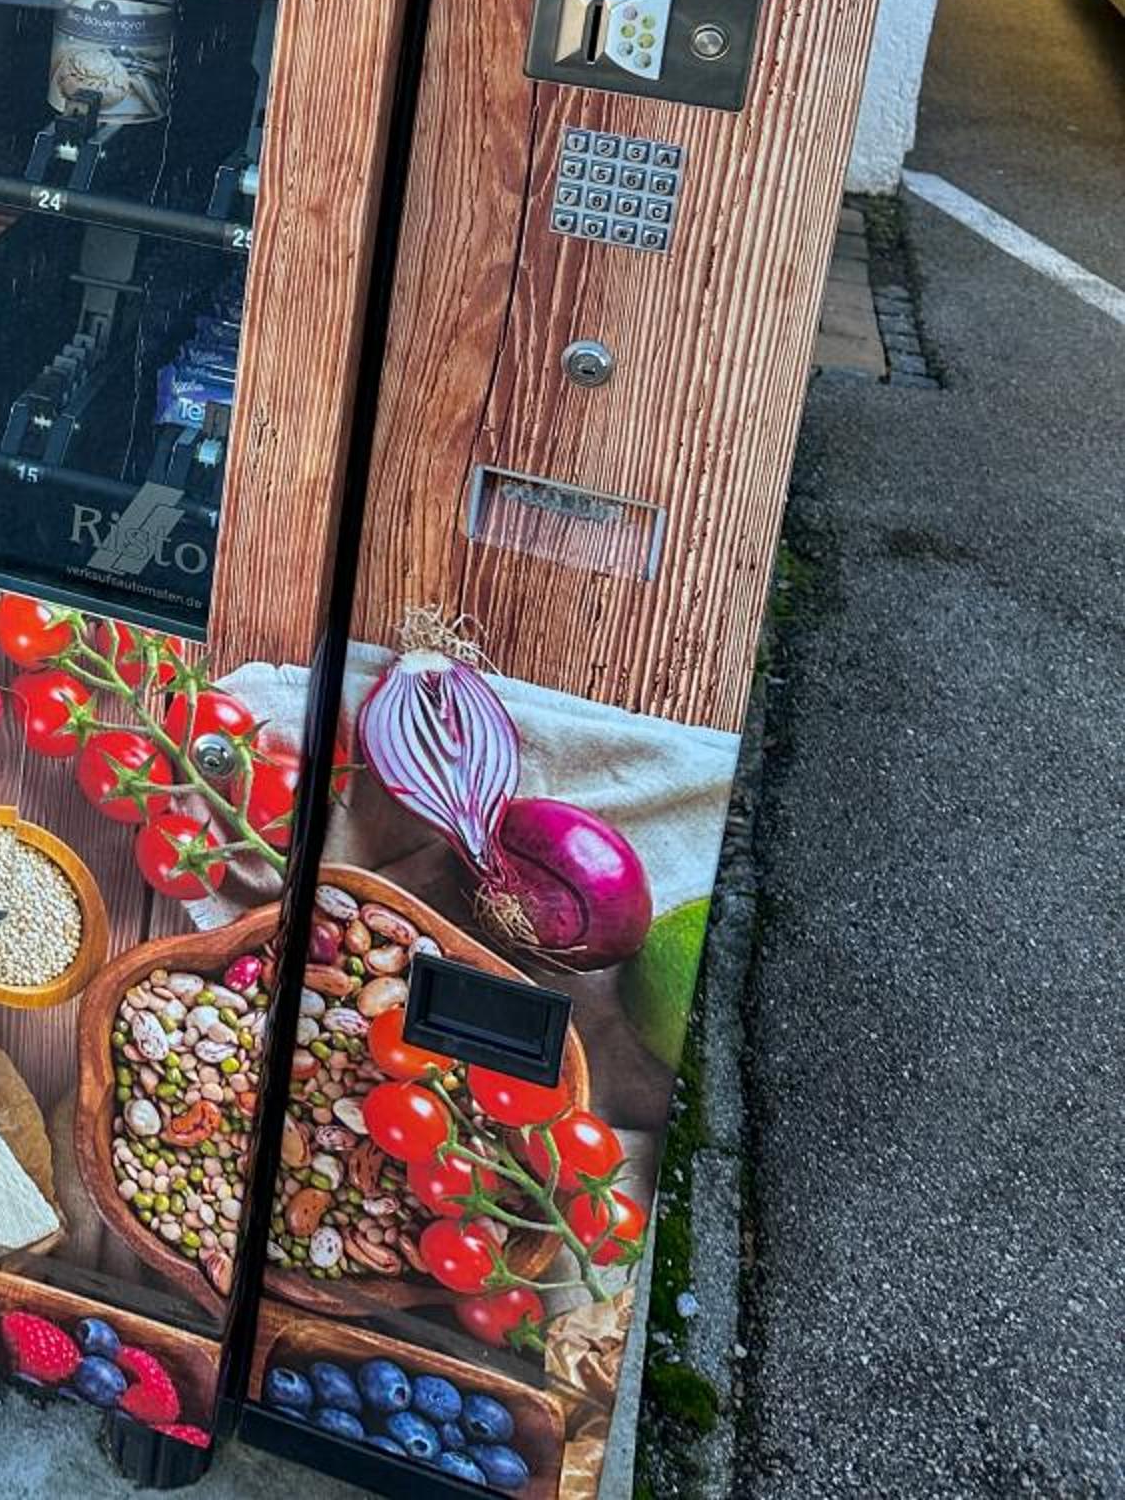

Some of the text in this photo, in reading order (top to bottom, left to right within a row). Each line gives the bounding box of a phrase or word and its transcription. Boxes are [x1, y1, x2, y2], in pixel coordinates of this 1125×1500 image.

[573, 136, 671, 165] 1 2 3 A
[566, 164, 576, 174] 4
[596, 169, 606, 181] 5
[626, 175, 636, 187] 6
[38, 192, 61, 210] 24
[563, 191, 662, 219] 7 8 9 C
[588, 222, 598, 234] 0
[17, 466, 39, 483] 15
[208, 510, 218, 528] 1
[70, 503, 208, 574] Risto
